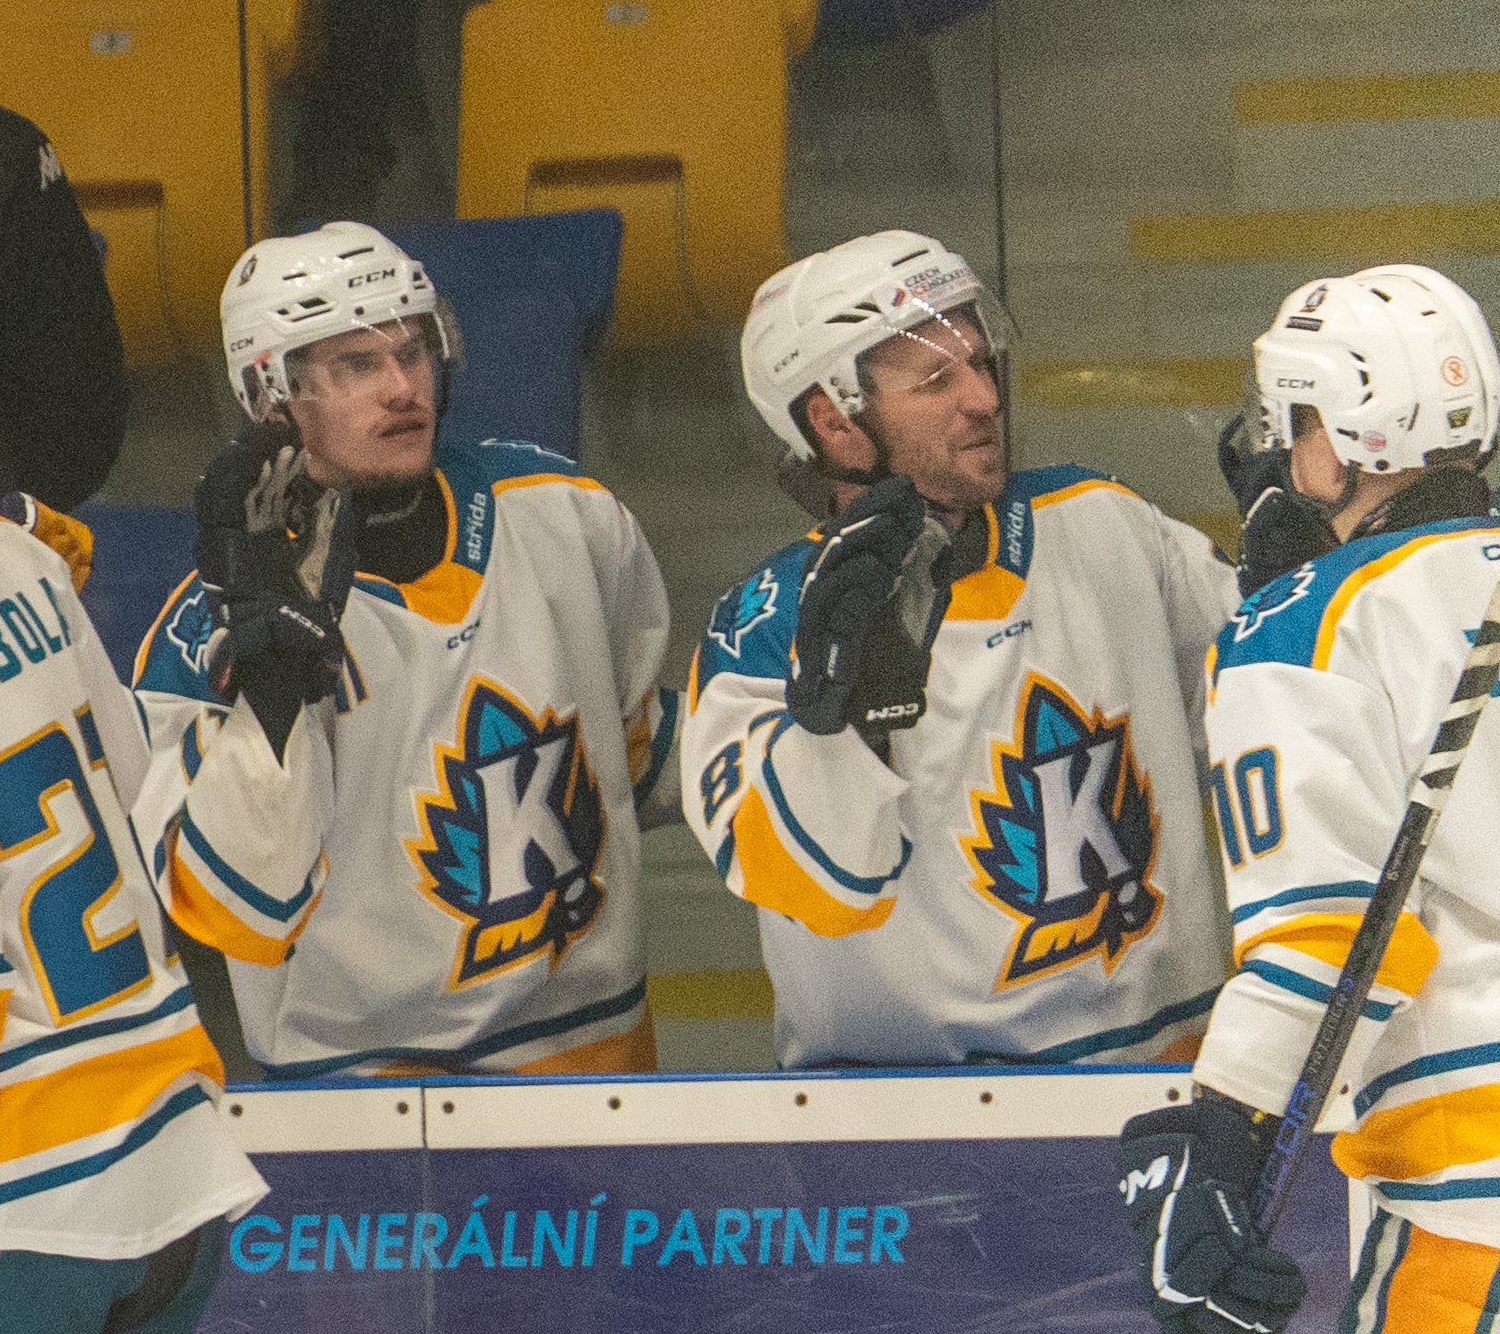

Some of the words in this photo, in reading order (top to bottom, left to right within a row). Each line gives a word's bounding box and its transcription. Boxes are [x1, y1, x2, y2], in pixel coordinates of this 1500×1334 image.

[347, 267, 397, 288] CCM
[1278, 378, 1315, 390] CCM
[1208, 744, 1285, 872] 10
[228, 1193, 608, 1276] GENERÁLNÍ
[621, 1204, 909, 1266] PARTNER
